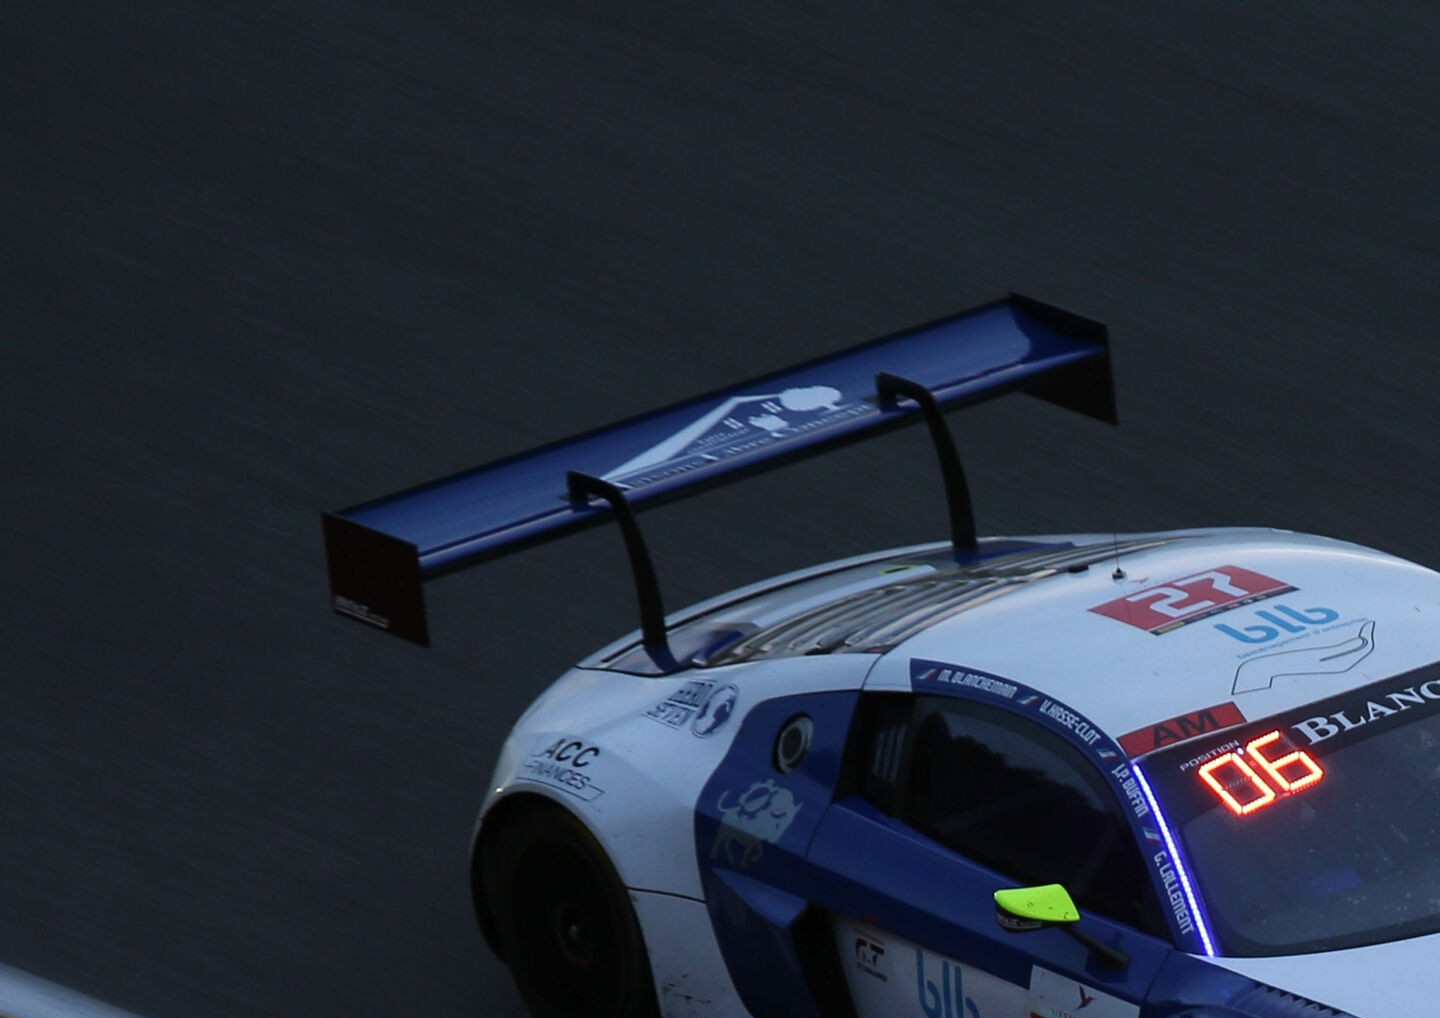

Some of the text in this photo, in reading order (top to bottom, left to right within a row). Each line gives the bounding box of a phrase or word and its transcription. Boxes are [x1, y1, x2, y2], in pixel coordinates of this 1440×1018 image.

[1125, 571, 1250, 618] 27
[1213, 604, 1340, 644] blb
[1153, 711, 1220, 746] AM
[545, 738, 599, 768] ACC
[1179, 740, 1240, 772] POSITION
[1198, 729, 1324, 815] 06
[526, 760, 591, 790] FINANCES
[1122, 777, 1149, 818] BUFFIN
[1159, 862, 1194, 935] LALLEMENT
